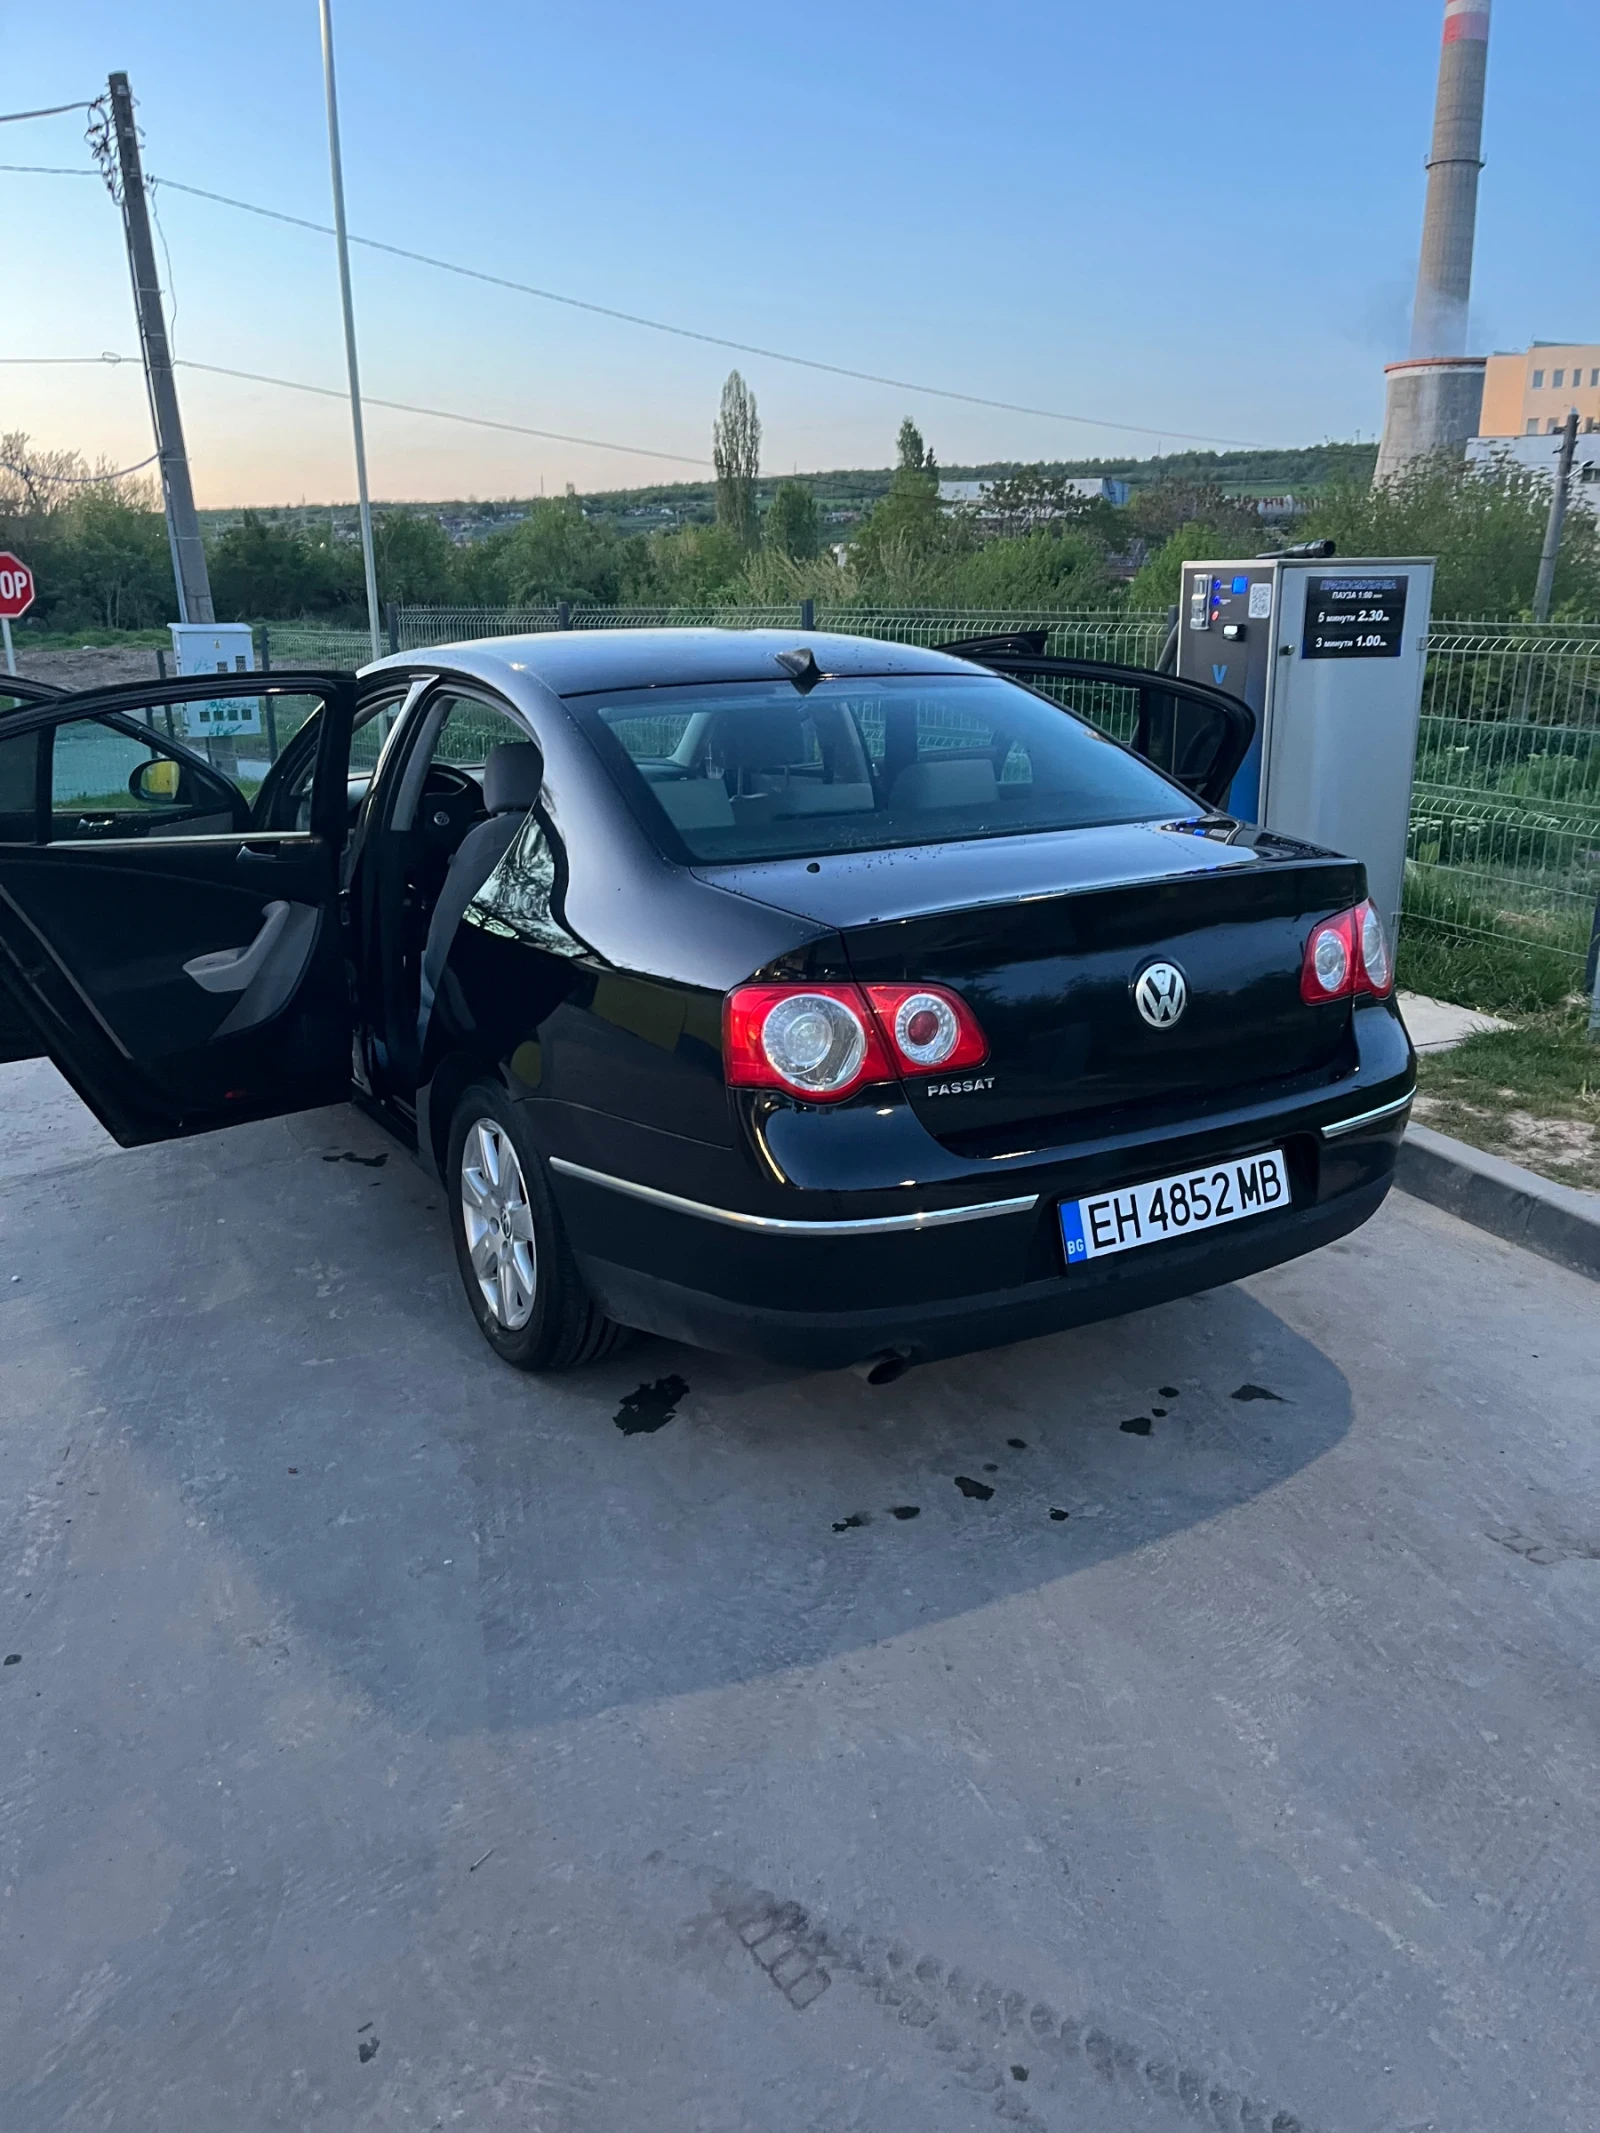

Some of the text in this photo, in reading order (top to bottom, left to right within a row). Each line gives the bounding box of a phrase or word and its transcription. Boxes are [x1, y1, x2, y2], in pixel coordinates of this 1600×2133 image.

[0, 570, 28, 600] OP
[1332, 591, 1357, 600] ПАУЗА
[1317, 612, 1325, 623] 5
[1325, 615, 1356, 625] минути
[1315, 637, 1323, 648] 3
[1323, 640, 1353, 650] минути
[927, 1077, 996, 1097] PASSAT
[1067, 1238, 1085, 1255] BG
